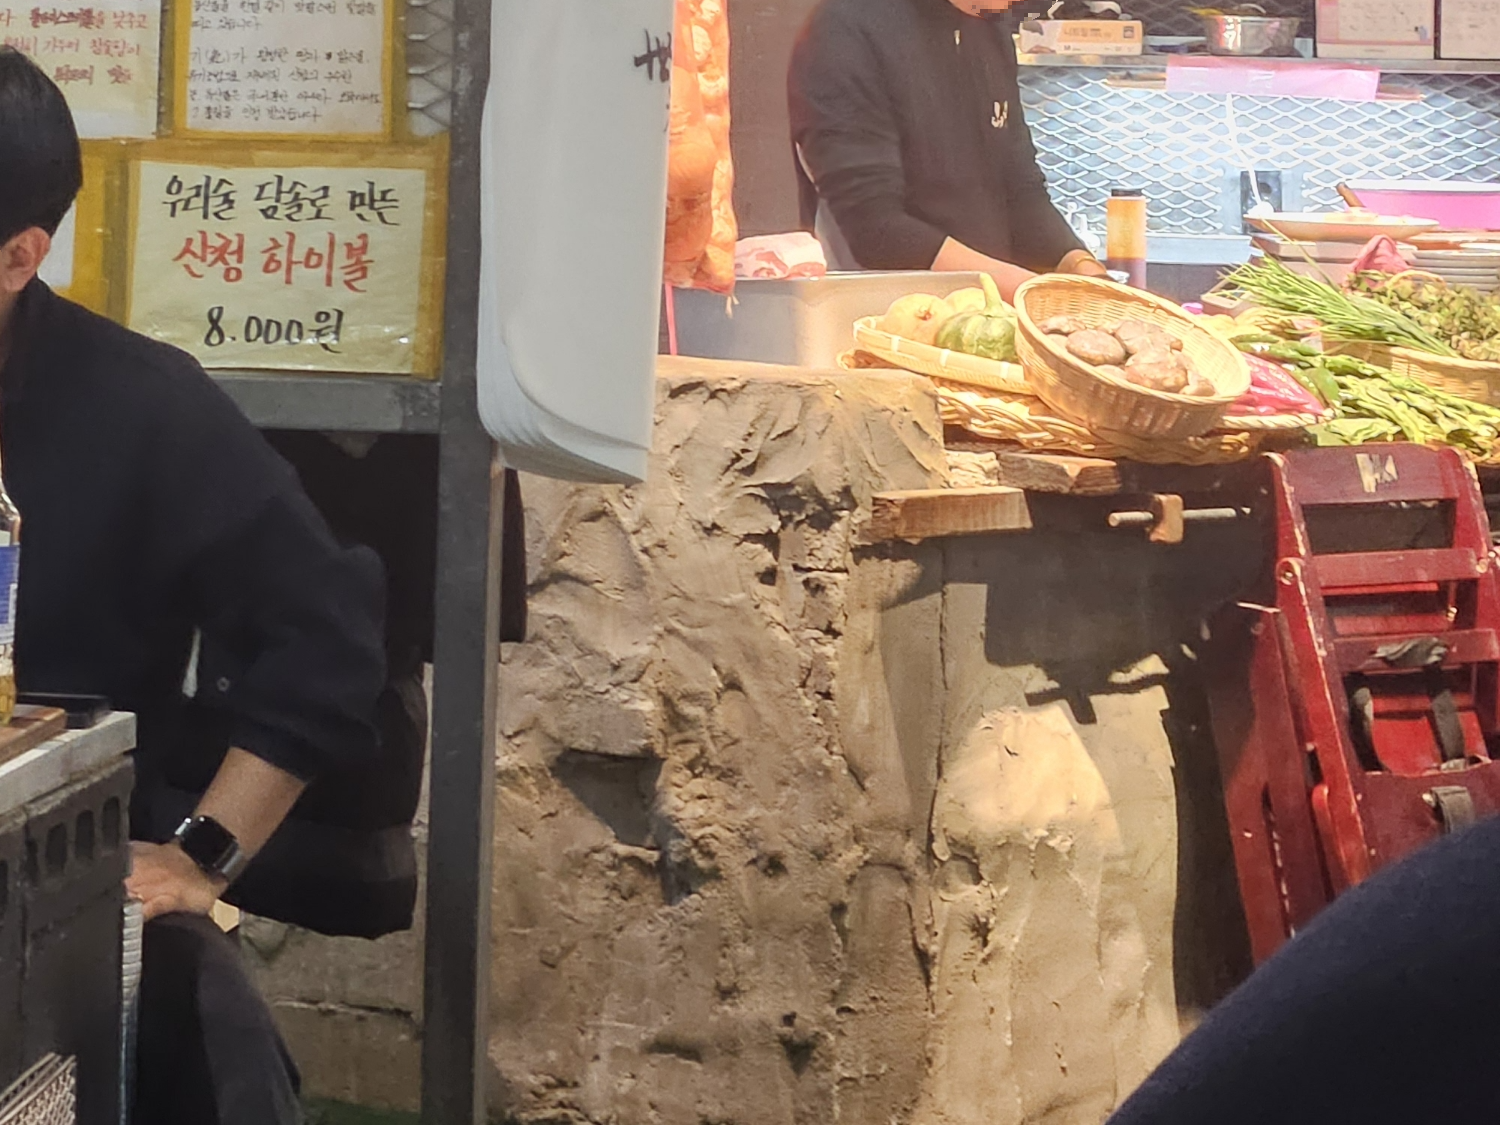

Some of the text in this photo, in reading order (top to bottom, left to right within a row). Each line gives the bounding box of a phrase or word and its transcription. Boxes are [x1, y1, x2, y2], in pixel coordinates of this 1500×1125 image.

[161, 173, 401, 226] 우리술 담솔로 만든
[171, 230, 375, 293] 산청 하이볼
[203, 306, 345, 354] 8.000원
